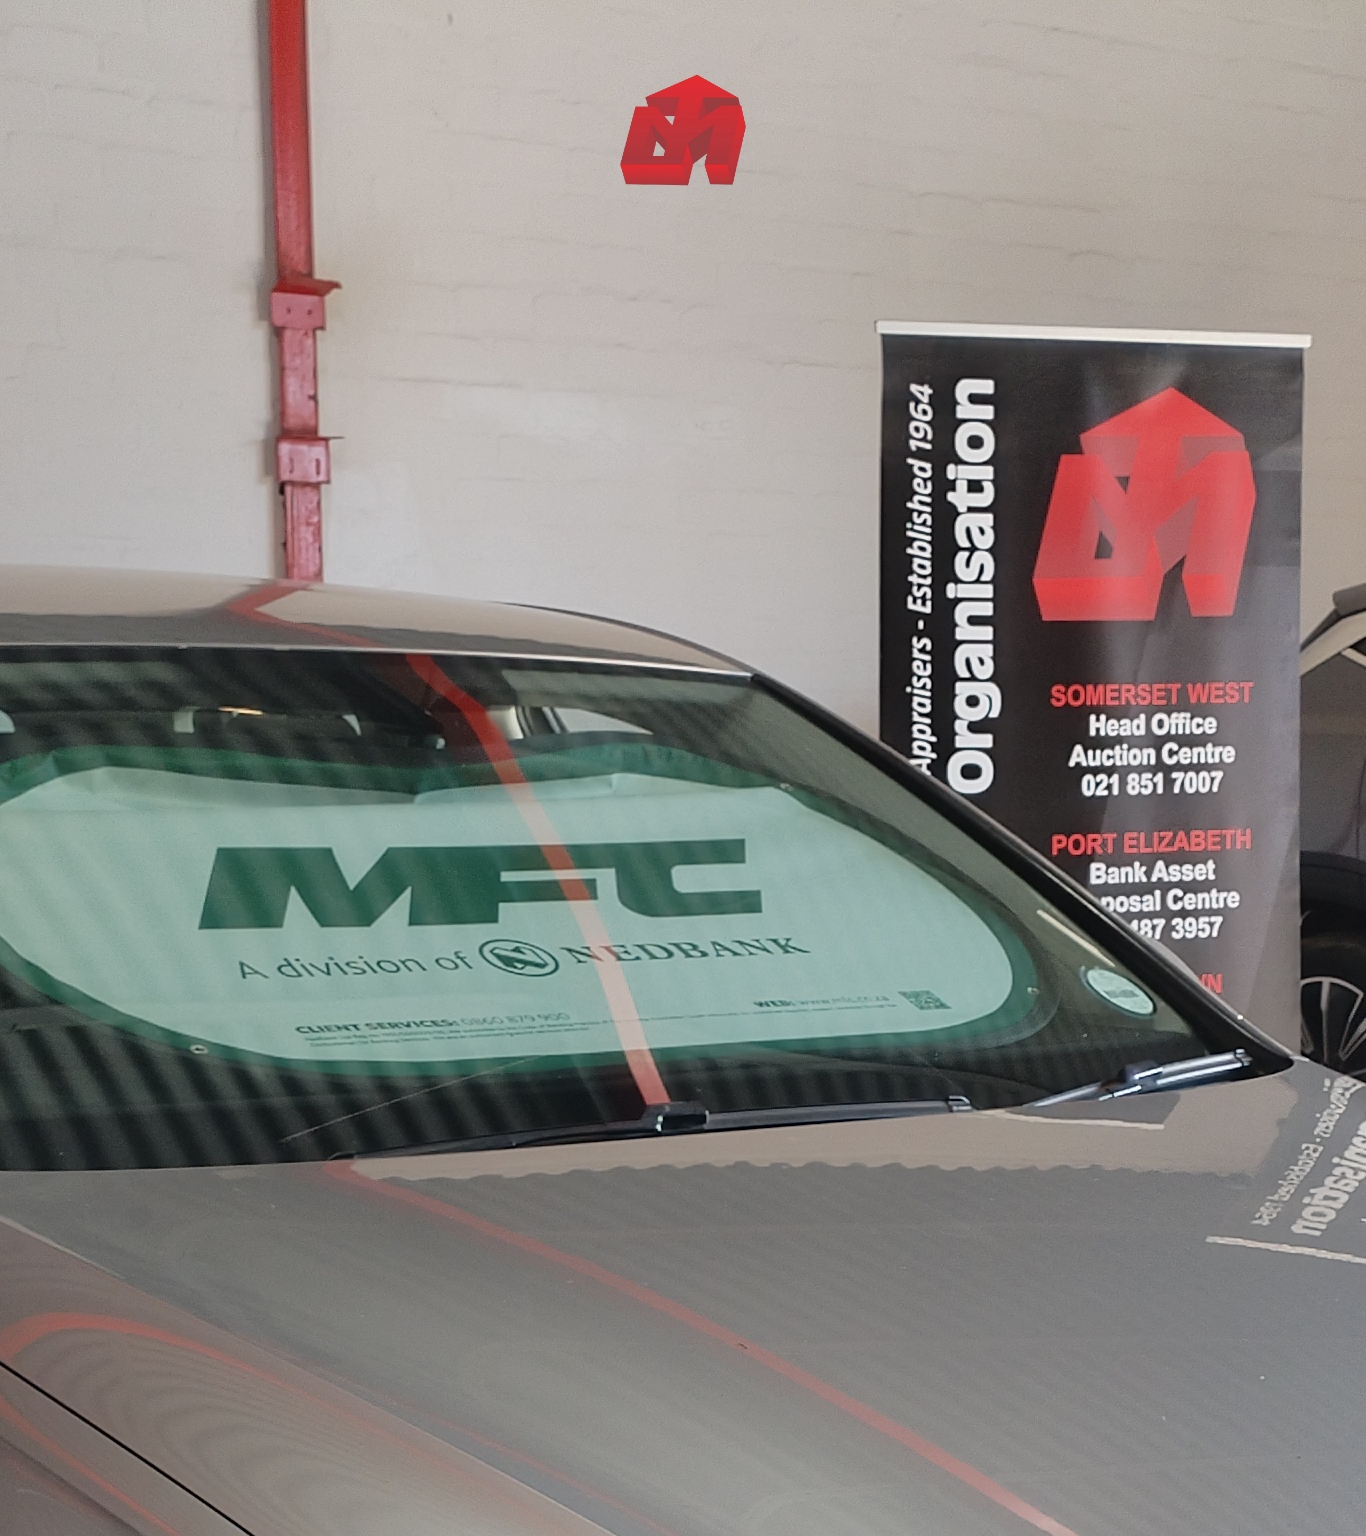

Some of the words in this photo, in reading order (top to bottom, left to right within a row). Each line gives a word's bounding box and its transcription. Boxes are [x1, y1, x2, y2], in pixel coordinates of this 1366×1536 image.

[907, 383, 934, 451] 1964
[906, 457, 934, 614] Established
[946, 378, 1002, 794] Organisation
[1050, 682, 1181, 708] SOMERSET
[1187, 681, 1254, 703] WEST
[1088, 713, 1146, 736] Head
[1151, 712, 1218, 735] Office
[1068, 744, 1156, 768] Auction
[1161, 742, 1236, 766] Centre
[1081, 774, 1121, 797] 021
[1125, 772, 1164, 796] 851
[1170, 770, 1224, 794] 7007
[1050, 832, 1117, 856] PORT
[1123, 827, 1252, 854] ELIZABETH
[198, 838, 763, 930] MFC
[1089, 862, 1147, 885] Bank
[1151, 859, 1216, 882] Asset
[1100, 889, 1162, 913] posal
[1166, 888, 1241, 911] Centre
[1171, 915, 1224, 939] 3957
[238, 960, 269, 980] A
[276, 956, 427, 978] division
[435, 950, 474, 972] of
[560, 937, 811, 964] NEDBANK
[295, 1022, 361, 1034] CLIENT
